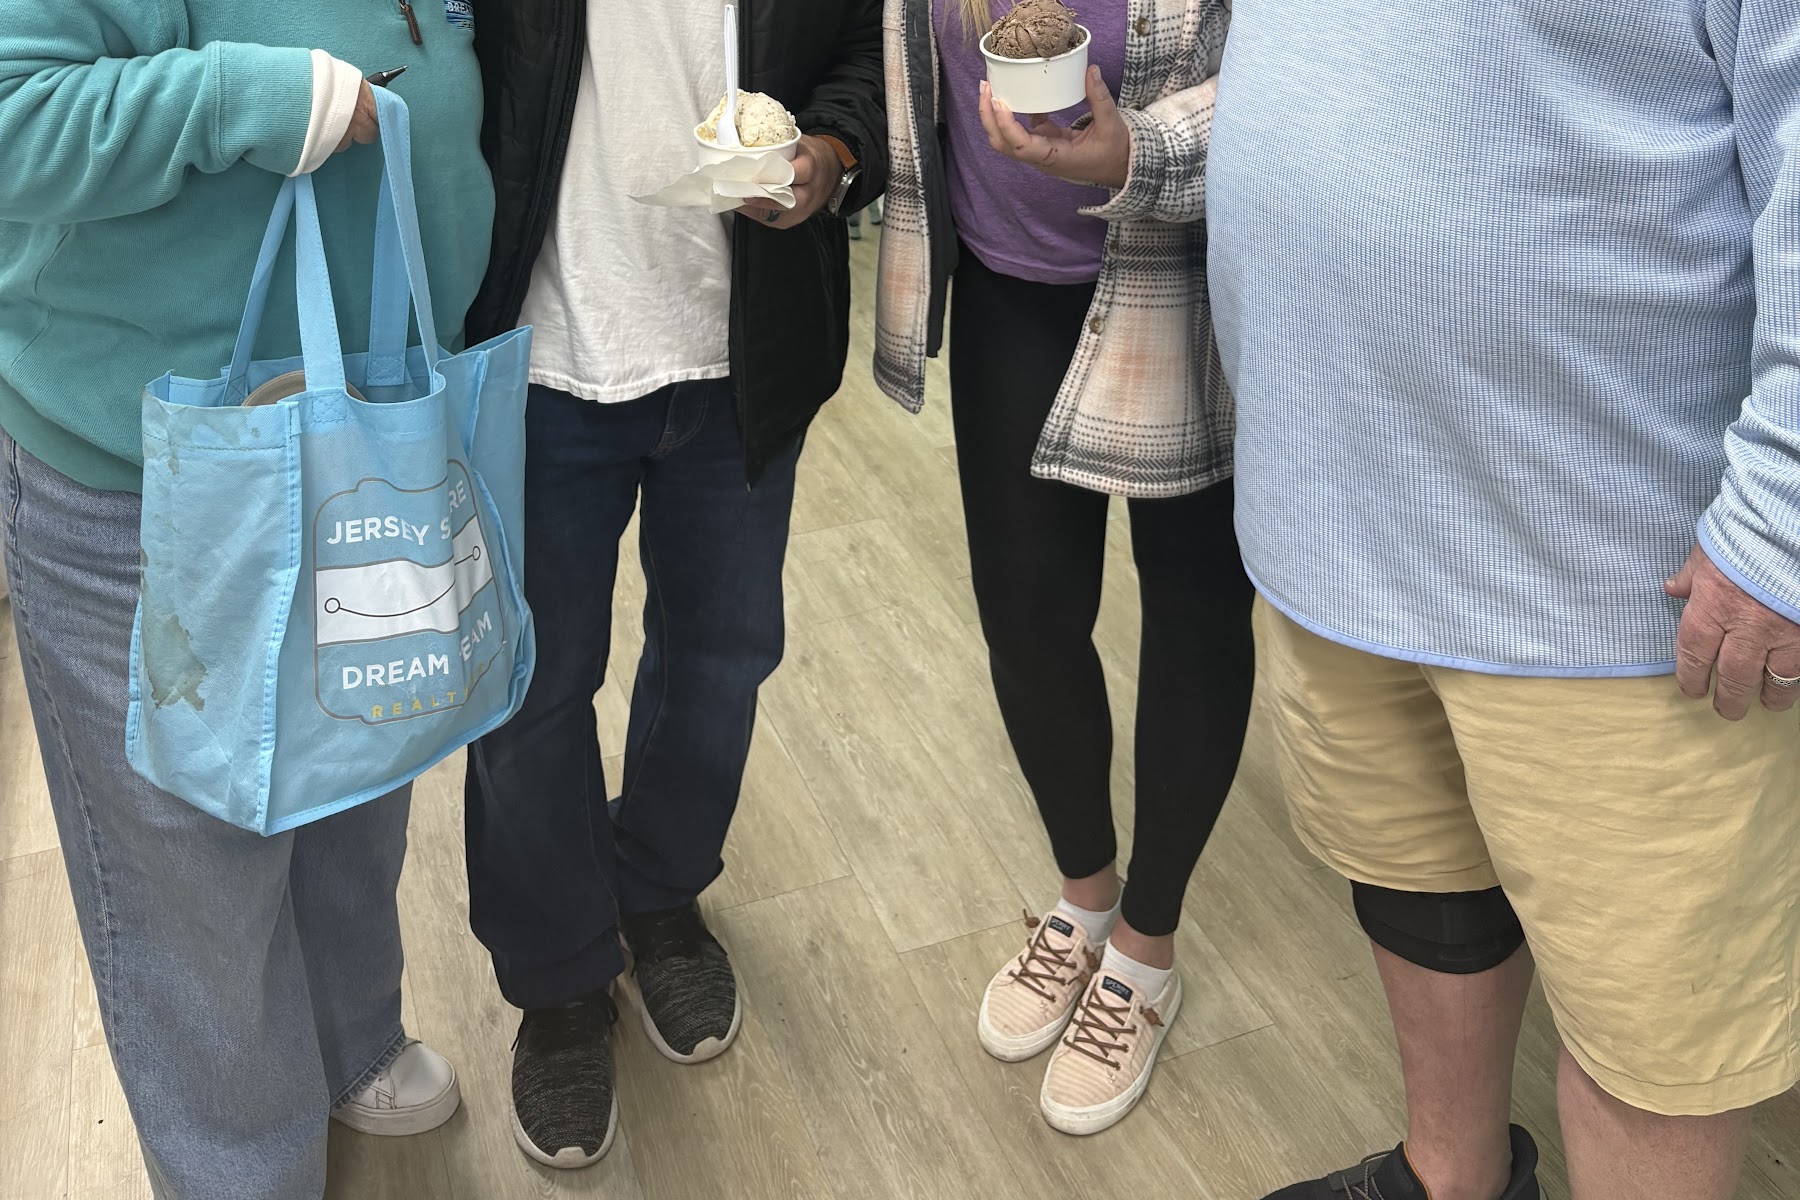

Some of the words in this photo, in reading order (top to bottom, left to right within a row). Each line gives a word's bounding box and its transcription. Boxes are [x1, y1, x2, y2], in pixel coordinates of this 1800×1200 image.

[326, 515, 430, 546] JERSEY
[441, 480, 467, 540] SRE
[342, 653, 450, 690] DREAM
[459, 611, 493, 662] EAM
